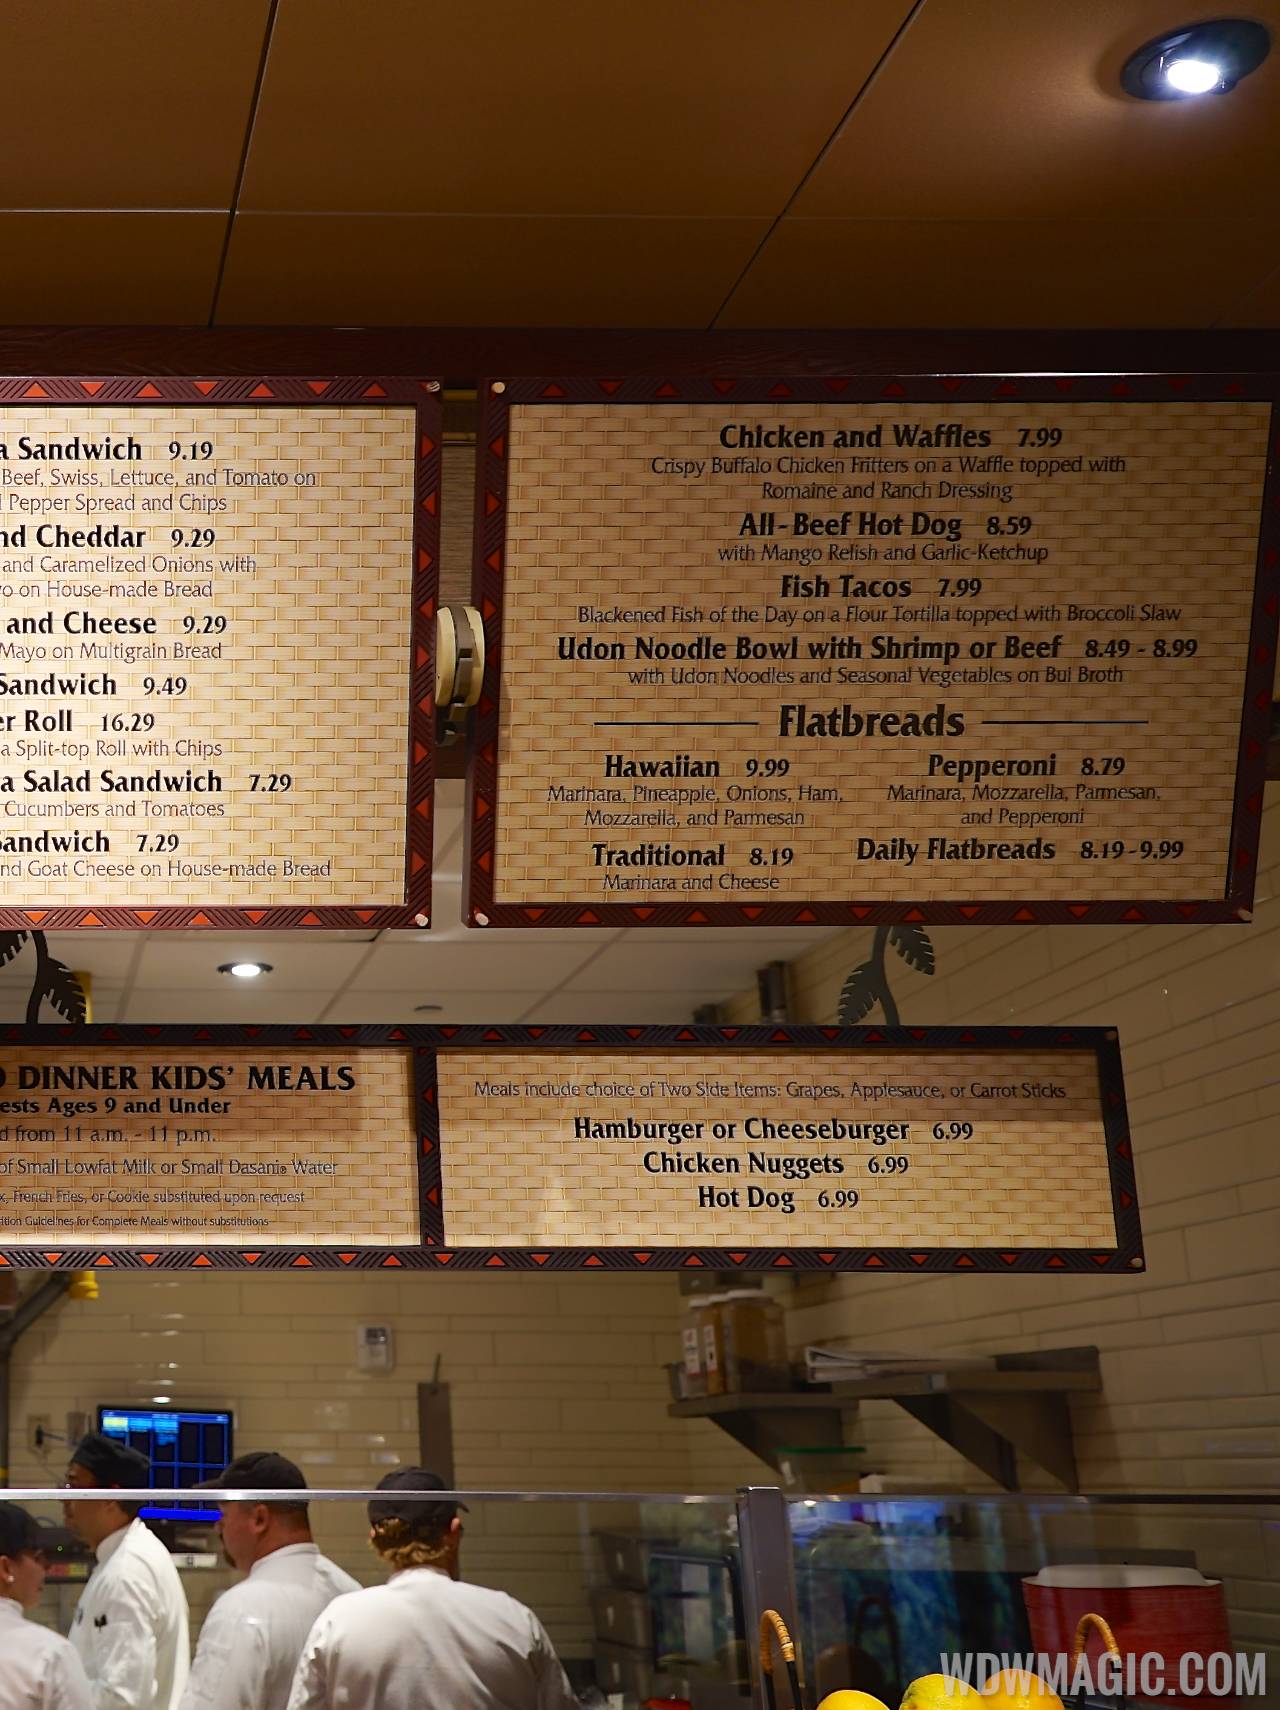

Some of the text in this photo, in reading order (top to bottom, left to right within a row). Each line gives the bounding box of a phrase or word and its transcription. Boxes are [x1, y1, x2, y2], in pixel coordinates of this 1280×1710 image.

[720, 424, 1062, 448] Chicken and Waffles 7.99
[19, 437, 142, 460] Sandwich
[169, 441, 212, 460] 9.19
[763, 481, 1013, 503] Romaine and Ranch Dressing
[10, 494, 70, 515] Pepper
[76, 494, 135, 515] Spread
[142, 494, 172, 510] and
[180, 494, 226, 515] Chips
[37, 525, 146, 547] Cheddar
[171, 529, 215, 547] 9.29
[19, 586, 40, 597] on
[48, 580, 157, 597] House-made
[164, 580, 212, 597] Bread
[782, 575, 981, 597] Fish Tacos 7.99
[144, 677, 187, 695] 9.49
[25, 710, 72, 731] Roll
[102, 713, 154, 731] 16.29
[779, 704, 964, 737] Flatbreads
[604, 755, 790, 777] Hawaiian 9.99
[929, 754, 1125, 782] Pepperoni 8.79
[961, 808, 1086, 828] and Pepperoni
[137, 834, 179, 852] 7.29
[592, 844, 793, 866] Traditional 8.19
[603, 874, 779, 889] Marinara and Cheese
[18, 1066, 139, 1090] DINNER
[152, 1066, 233, 1090] KIDS'
[248, 1066, 355, 1090] MEALS
[475, 1082, 1065, 1101] Meals include choice of Two Side Items: Grapes, Applesauce, or Carrot Sticks
[48, 1098, 97, 1117] Ages
[105, 1097, 116, 1113] 9
[124, 1098, 160, 1113] and
[170, 1098, 230, 1113] Under
[16, 1125, 55, 1141] from
[64, 1126, 81, 1141] 11
[90, 1129, 128, 1141] a.m.
[151, 1126, 167, 1141] 11
[176, 1129, 215, 1146] p.m.
[644, 1151, 908, 1179] Chicken Nuggets 6.99
[699, 1186, 858, 1213] Hot Dog 6.99
